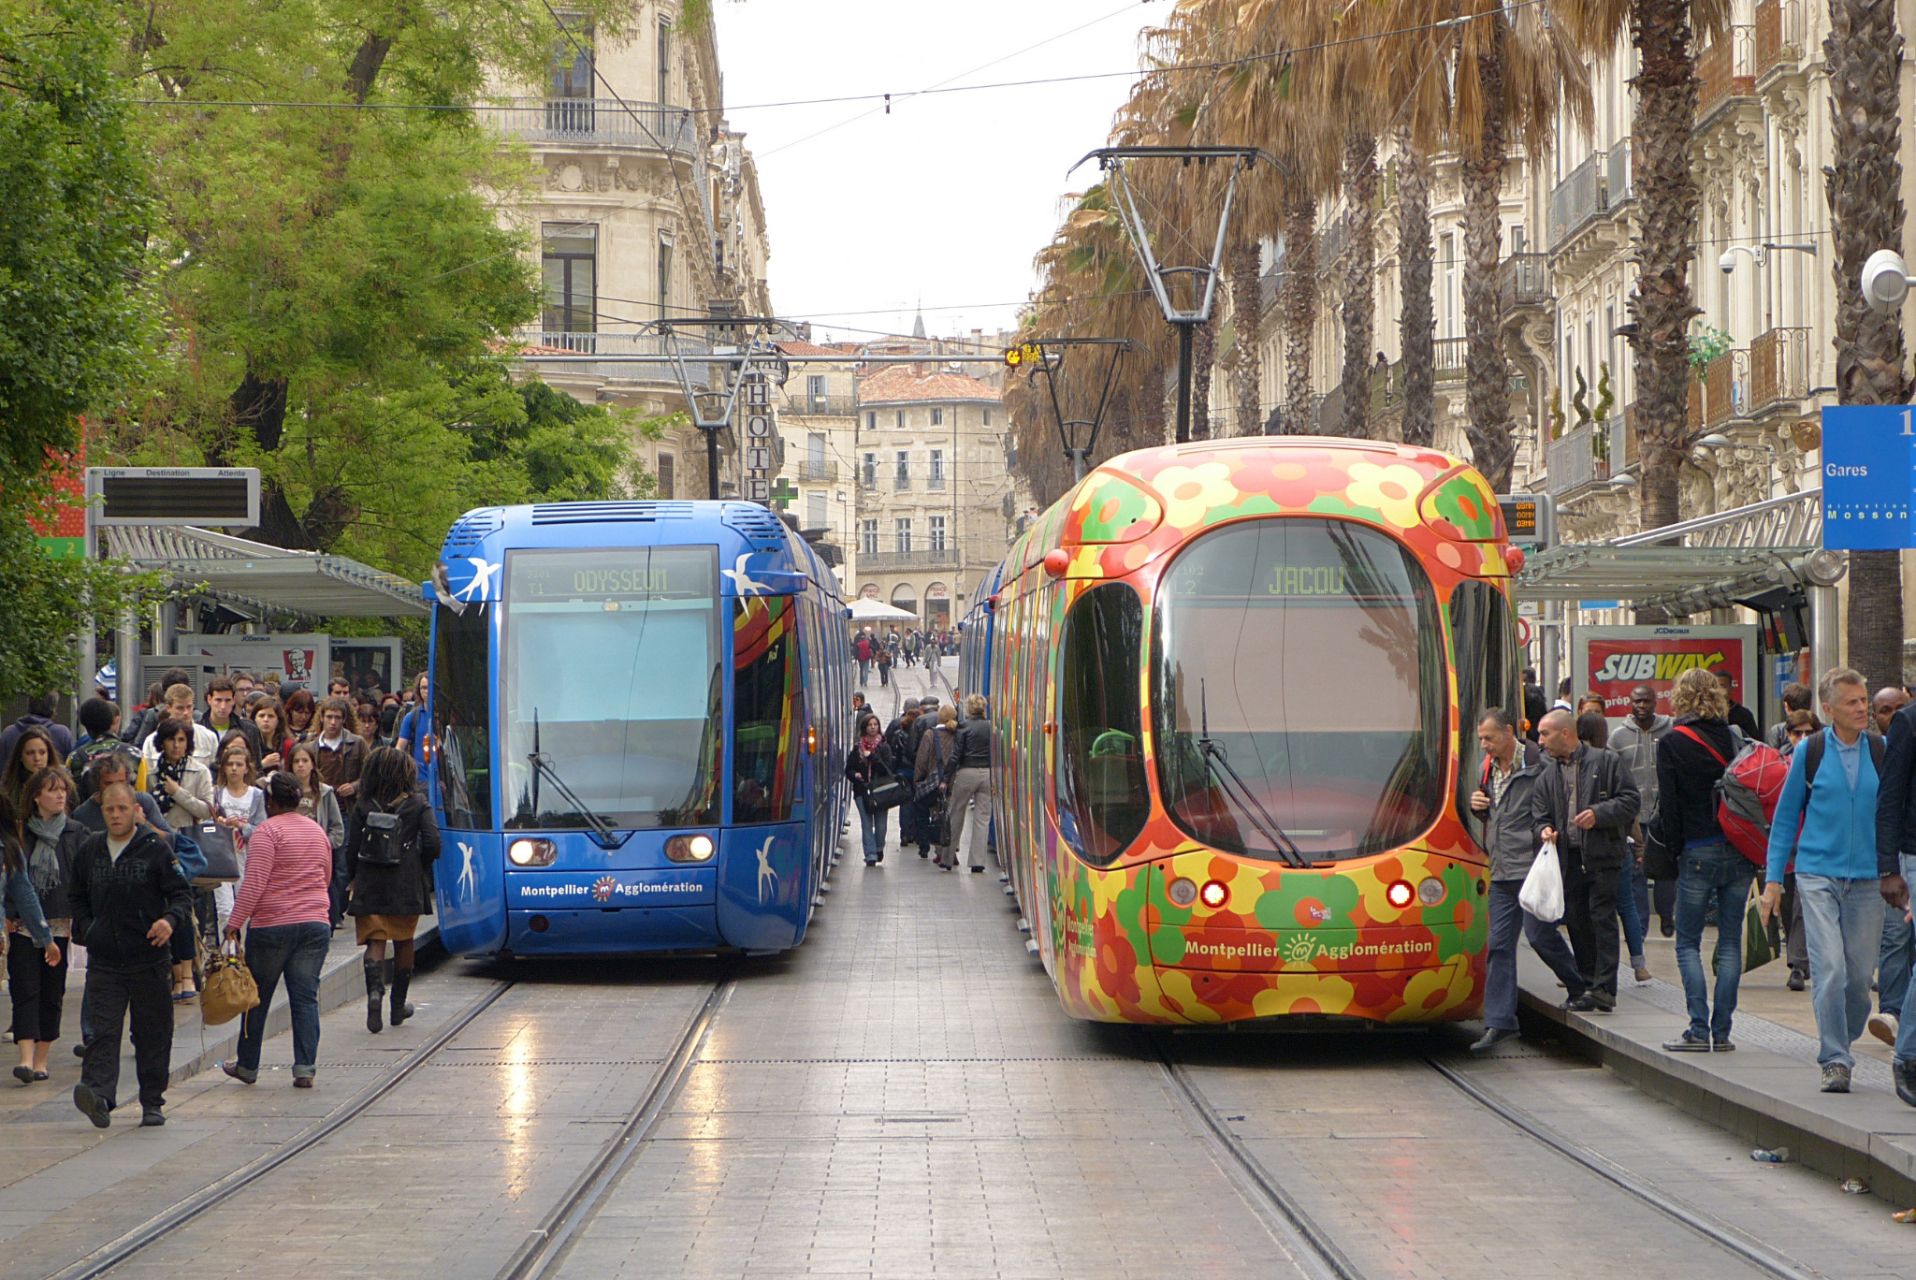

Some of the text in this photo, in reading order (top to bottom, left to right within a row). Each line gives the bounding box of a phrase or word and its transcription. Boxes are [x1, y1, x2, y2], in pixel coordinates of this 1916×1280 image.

[1898, 409, 1916, 436] 1
[104, 469, 125, 477] Ligne
[1826, 463, 1868, 477] Gares
[1827, 510, 1907, 519] Mosson
[67, 543, 75, 554] 2
[573, 568, 669, 592] ODYSSEUM
[1269, 566, 1345, 595] JACOU
[1595, 651, 1725, 682] SUBWAY
[521, 884, 589, 897] Montpellier
[614, 882, 703, 896] Agglomération
[1185, 941, 1280, 959] Montpellier
[1316, 940, 1433, 960] Agglomération
